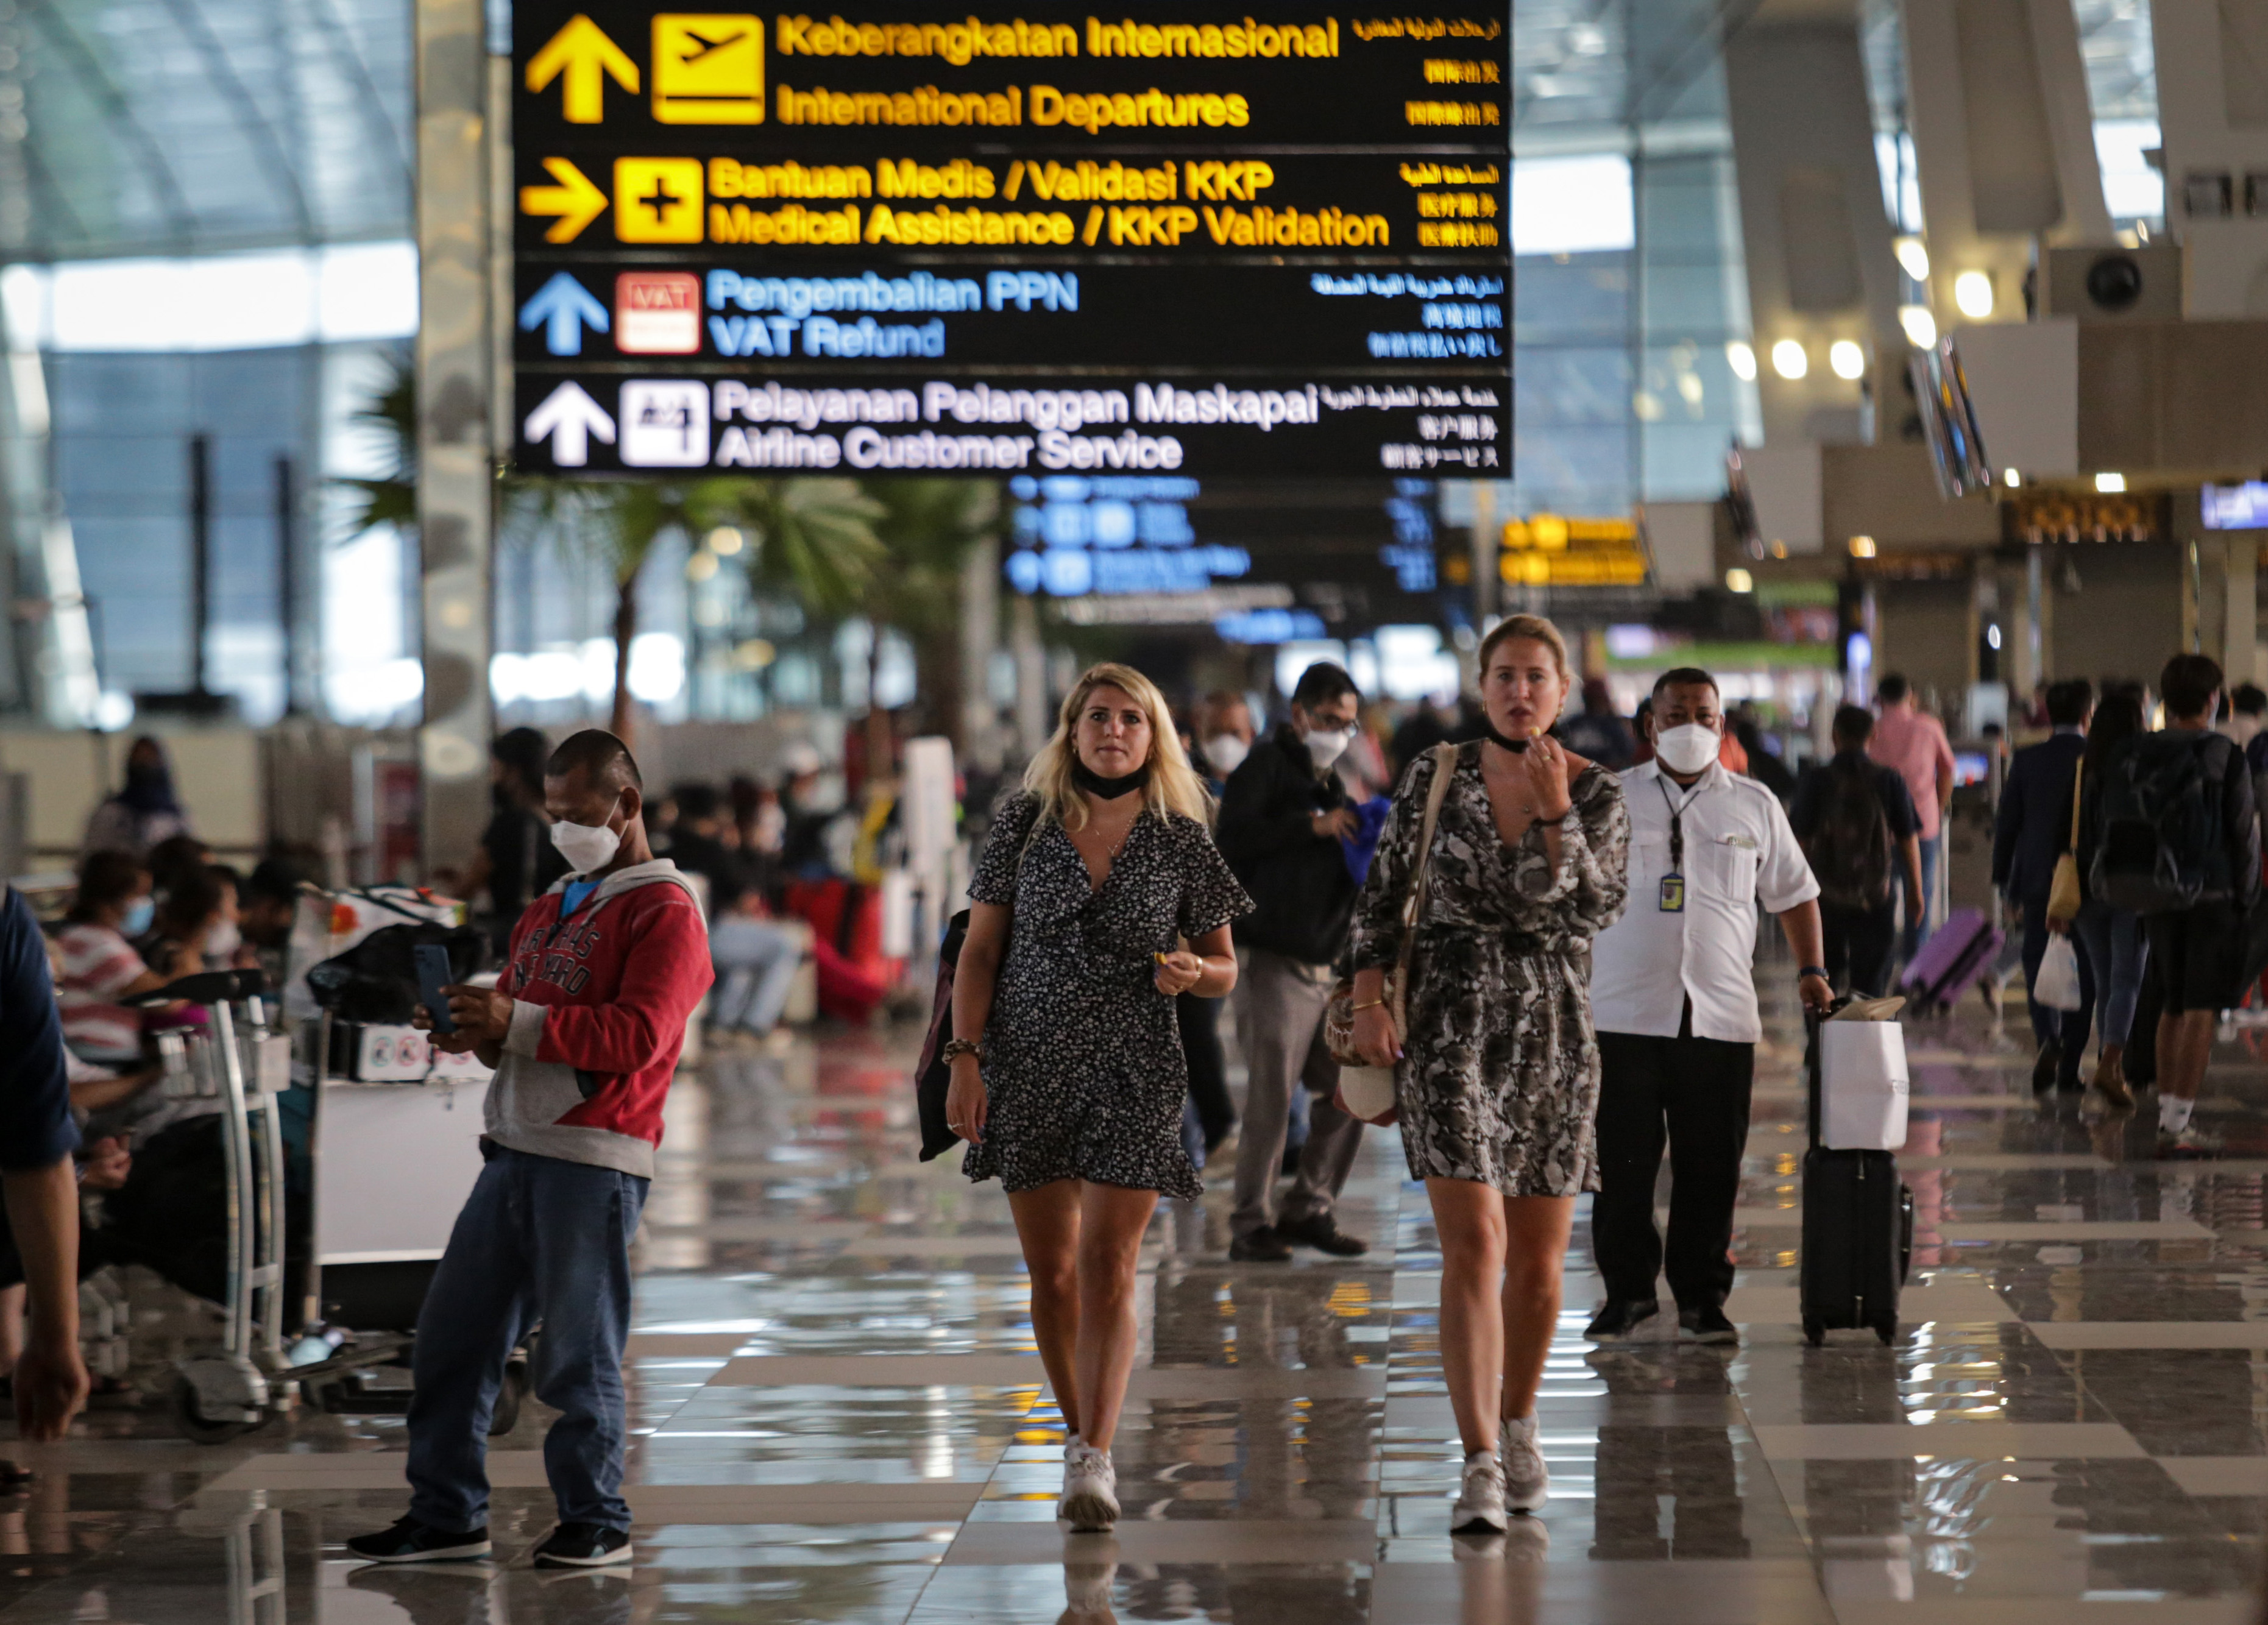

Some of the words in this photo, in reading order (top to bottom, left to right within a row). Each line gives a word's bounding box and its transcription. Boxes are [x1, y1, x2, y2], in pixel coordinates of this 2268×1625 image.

[776, 15, 1079, 66] Keberangkatan
[1086, 16, 1339, 58] Internasional
[776, 84, 1022, 126] International
[1029, 85, 1250, 135] Departures
[708, 157, 872, 199] Bantuan
[876, 158, 996, 199] Medis
[1184, 161, 1274, 200] KKP
[709, 204, 861, 244] Medical
[863, 204, 1075, 245] Assistance
[1202, 206, 1390, 246] Validation
[706, 269, 982, 319] Pengembalian
[986, 271, 1079, 312] PPN
[708, 316, 800, 357] VAT
[803, 316, 945, 358] Refund
[714, 380, 919, 430] Pelayanan
[922, 381, 1129, 432] Pelanggan
[1133, 382, 1319, 431] Maskapai
[715, 427, 842, 469] Airline
[843, 428, 1035, 469] Customer
[1037, 429, 1183, 470] Service
